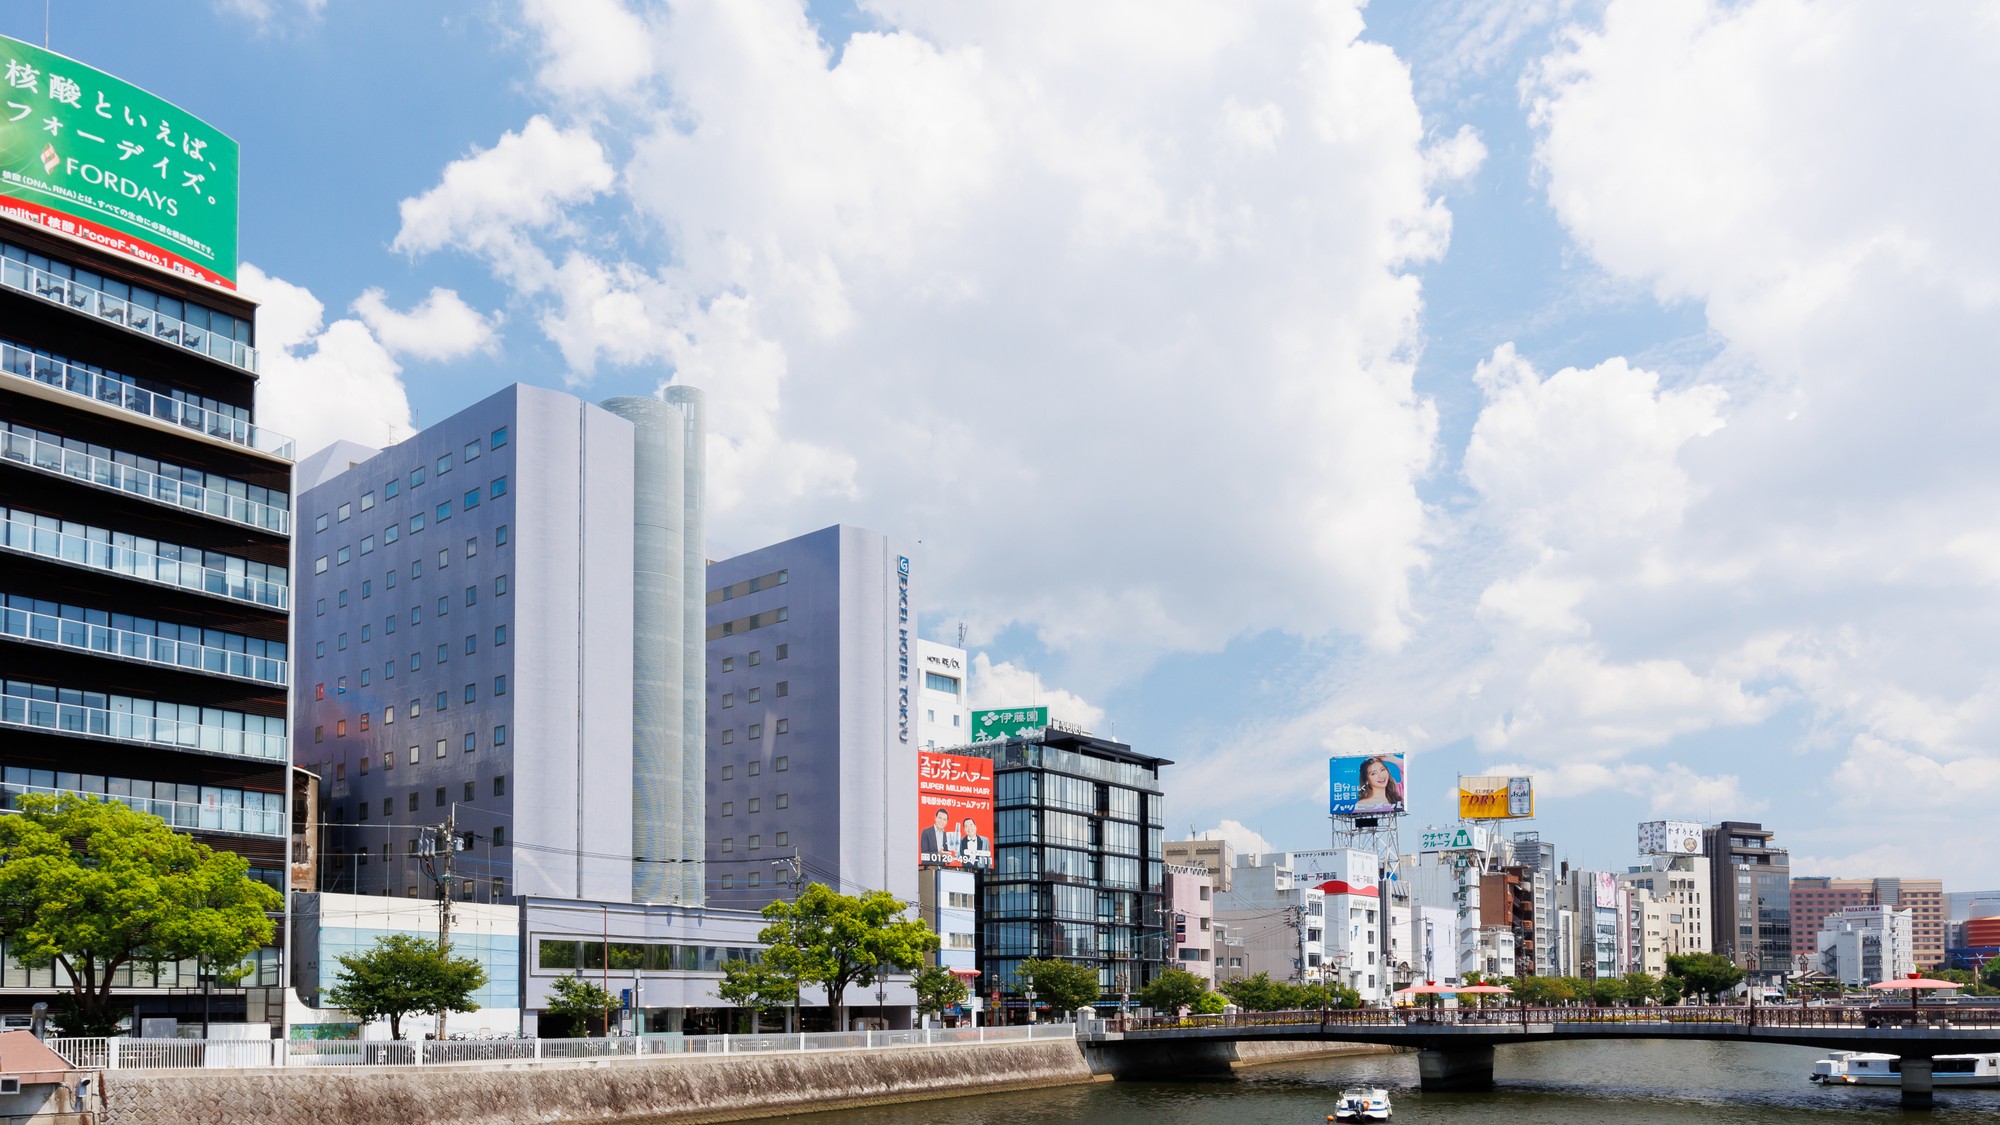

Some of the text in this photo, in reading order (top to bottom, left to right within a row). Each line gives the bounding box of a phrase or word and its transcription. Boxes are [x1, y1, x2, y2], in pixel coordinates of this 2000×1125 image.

[5, 58, 217, 172] 核酸といえば、
[66, 157, 179, 217] FORDAYS
[898, 574, 909, 745] EXCEL HOTEL TOKYU
[999, 710, 1039, 724] 伊藤園
[920, 755, 961, 769] スーパー
[920, 767, 991, 783] ミリオンヘアー
[920, 782, 990, 795] SUPER MILLION HAIR
[1333, 782, 1366, 793] 自分らしく
[1511, 790, 1529, 798] Asahi
[1422, 832, 1451, 841] ウチヤマ
[1422, 840, 1451, 848] グループ
